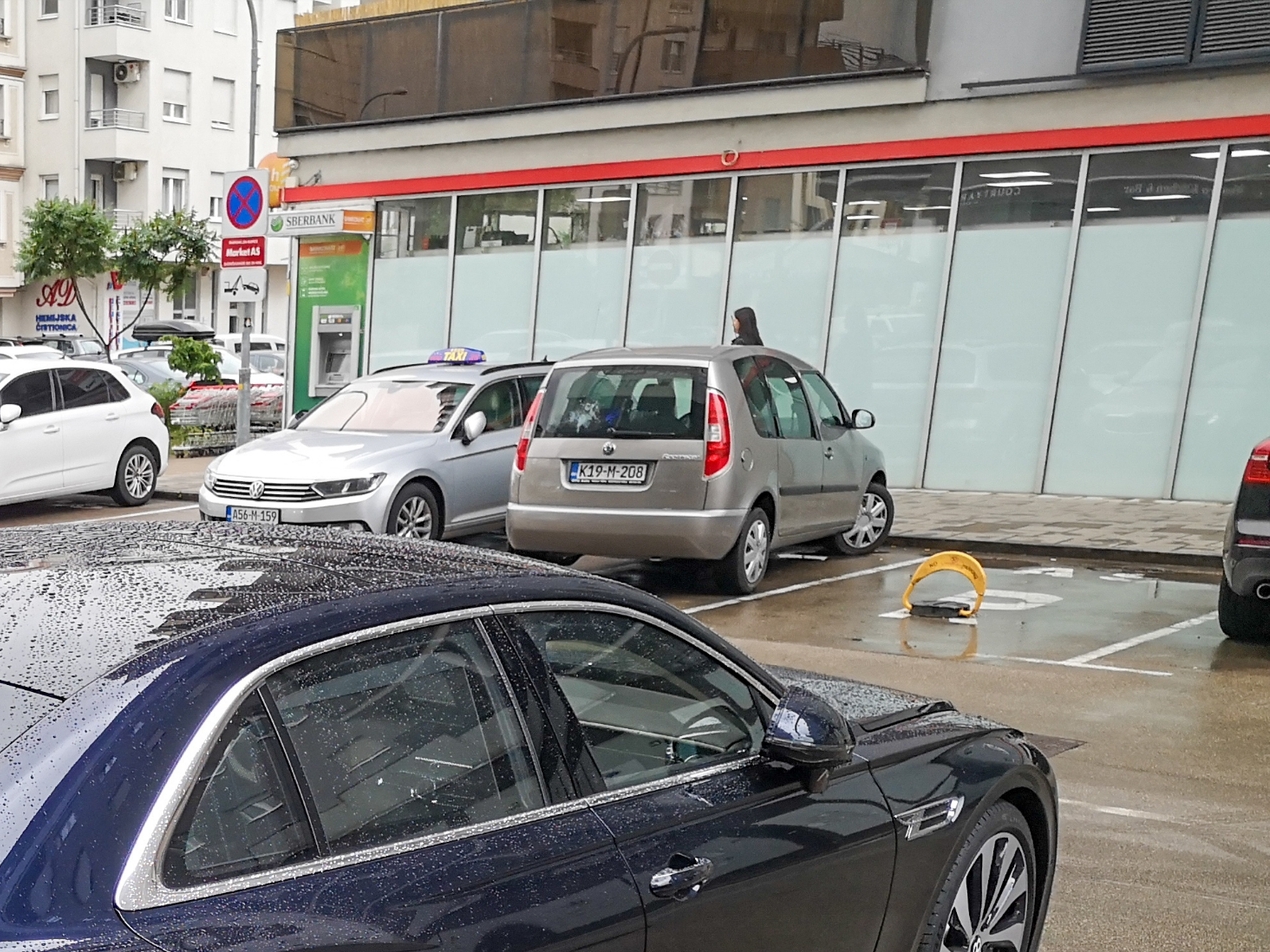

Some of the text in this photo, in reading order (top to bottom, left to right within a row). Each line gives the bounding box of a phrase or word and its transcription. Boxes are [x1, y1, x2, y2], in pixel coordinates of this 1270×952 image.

[286, 214, 335, 227] SBERBANK
[226, 246, 260, 257] Market AS
[35, 313, 77, 322] HEMIJSKA
[35, 322, 77, 331] ČISTIONICA
[443, 351, 467, 361] TAXI
[579, 464, 644, 478] K19-M-208
[232, 509, 277, 521] A56-M-159
